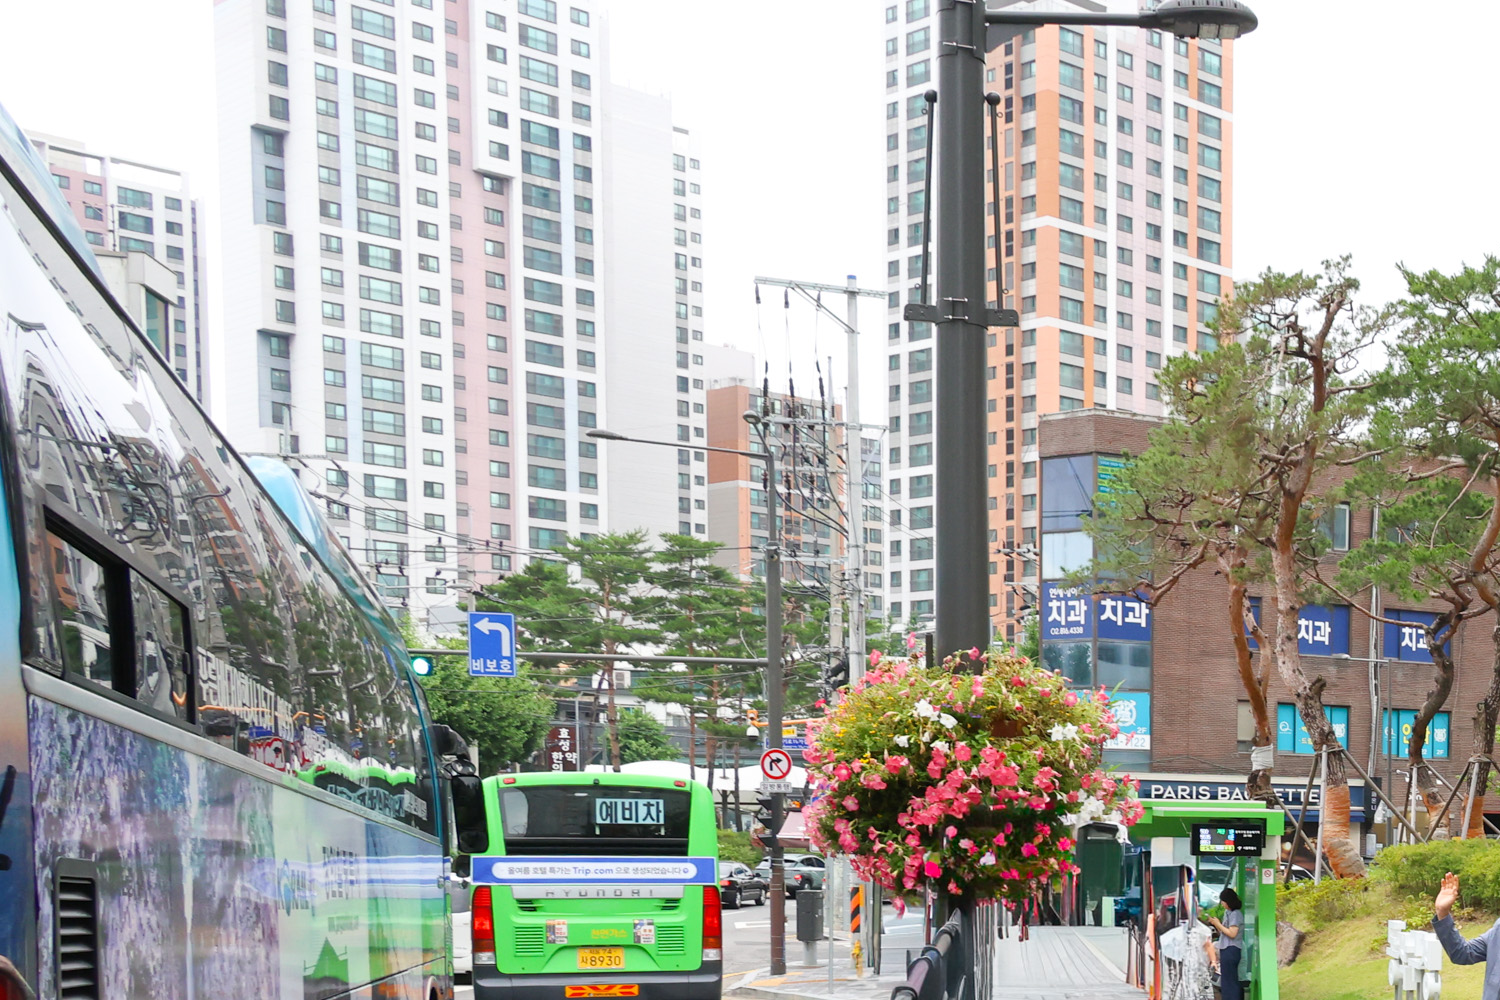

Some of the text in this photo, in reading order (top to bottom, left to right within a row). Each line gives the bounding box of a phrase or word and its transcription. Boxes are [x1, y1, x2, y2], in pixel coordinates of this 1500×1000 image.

[1048, 599, 1087, 626] 치과
[1100, 598, 1150, 628] 치과
[1298, 618, 1331, 646] 치과
[472, 657, 513, 674] 비보호
[1151, 785, 1211, 800] PARIS
[599, 801, 662, 824] 예비차
[508, 866, 530, 875] 올여름
[532, 866, 547, 875] 호텔
[549, 866, 572, 875] 특가는
[573, 866, 614, 876] Trip.com
[615, 866, 630, 875] 으로
[590, 955, 621, 967] 8930
